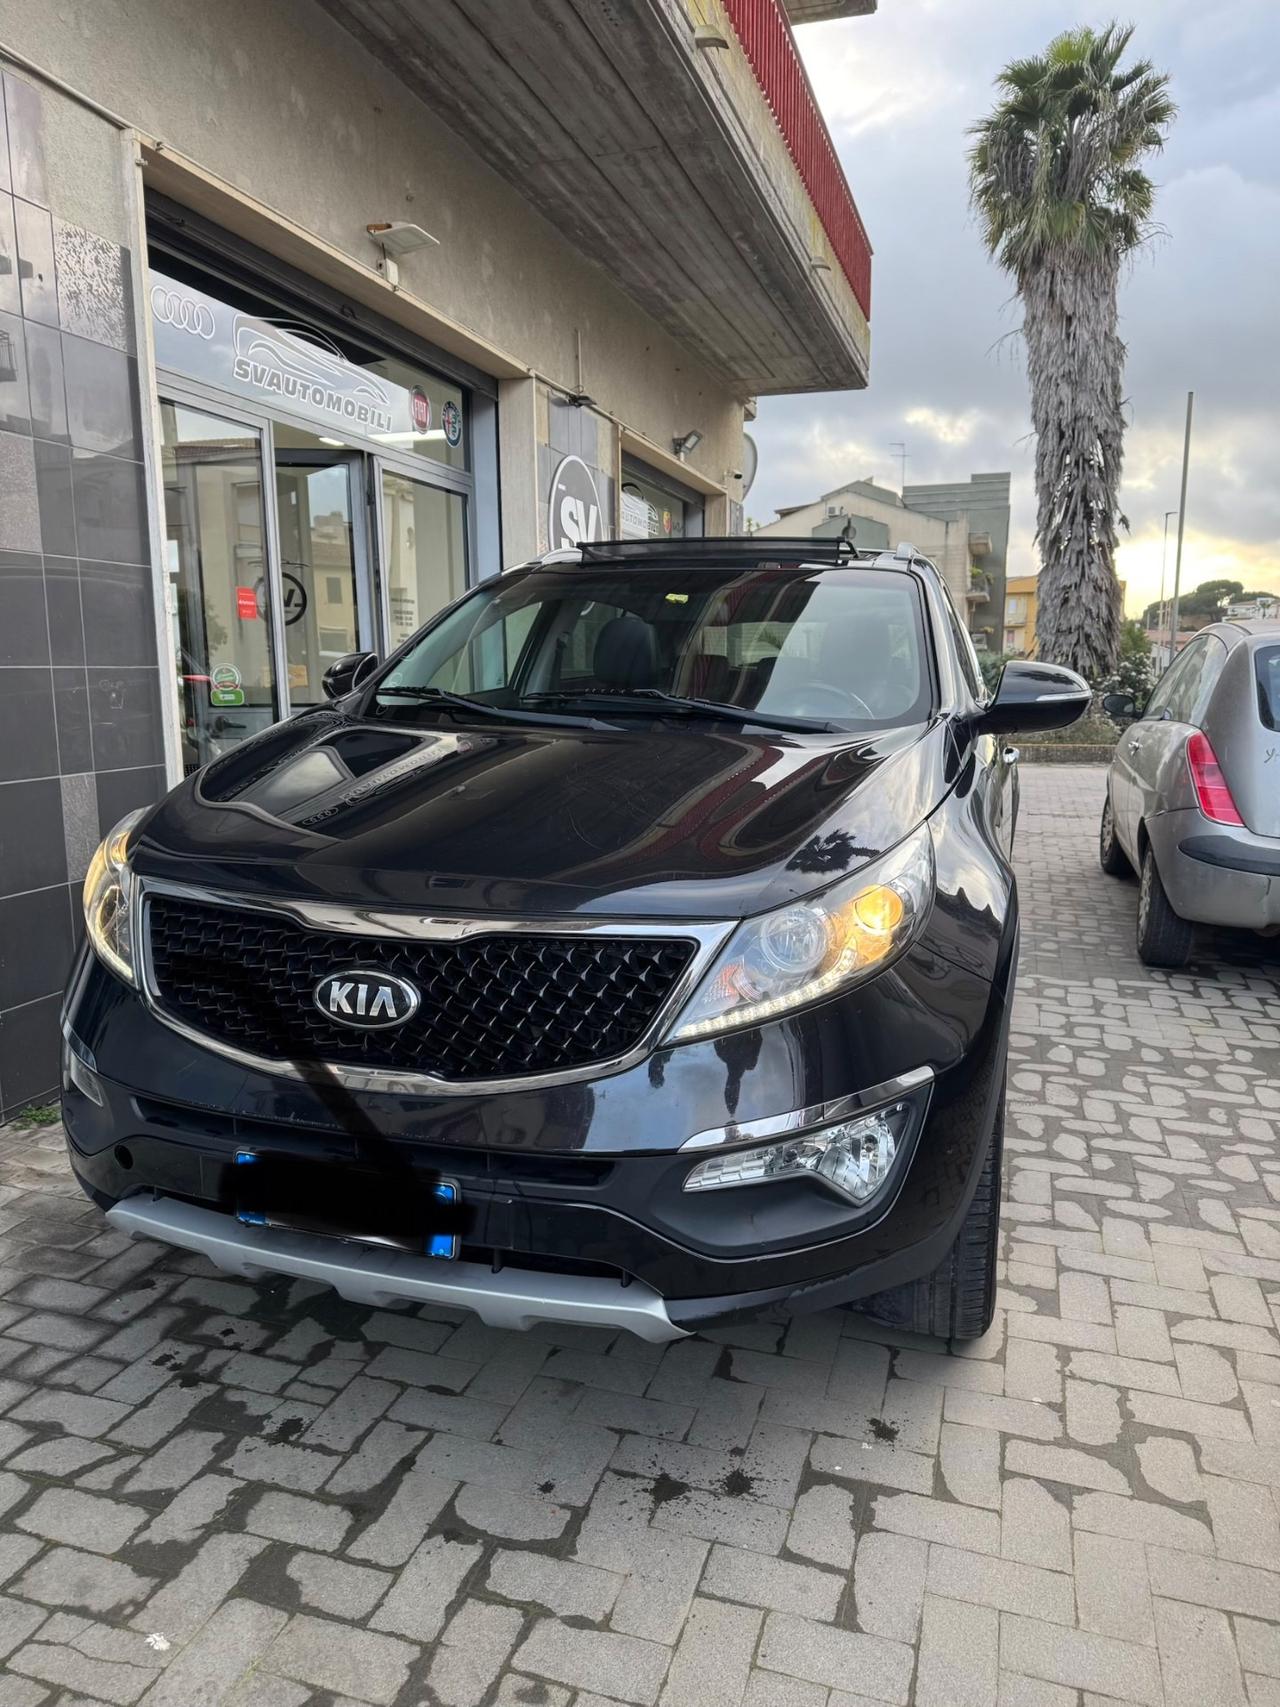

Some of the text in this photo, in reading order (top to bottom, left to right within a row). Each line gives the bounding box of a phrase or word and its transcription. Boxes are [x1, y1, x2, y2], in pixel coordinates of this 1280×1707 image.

[233, 356, 393, 432] SVAUTOMOBILI
[561, 496, 598, 548] SV
[329, 981, 398, 1018] KIA
